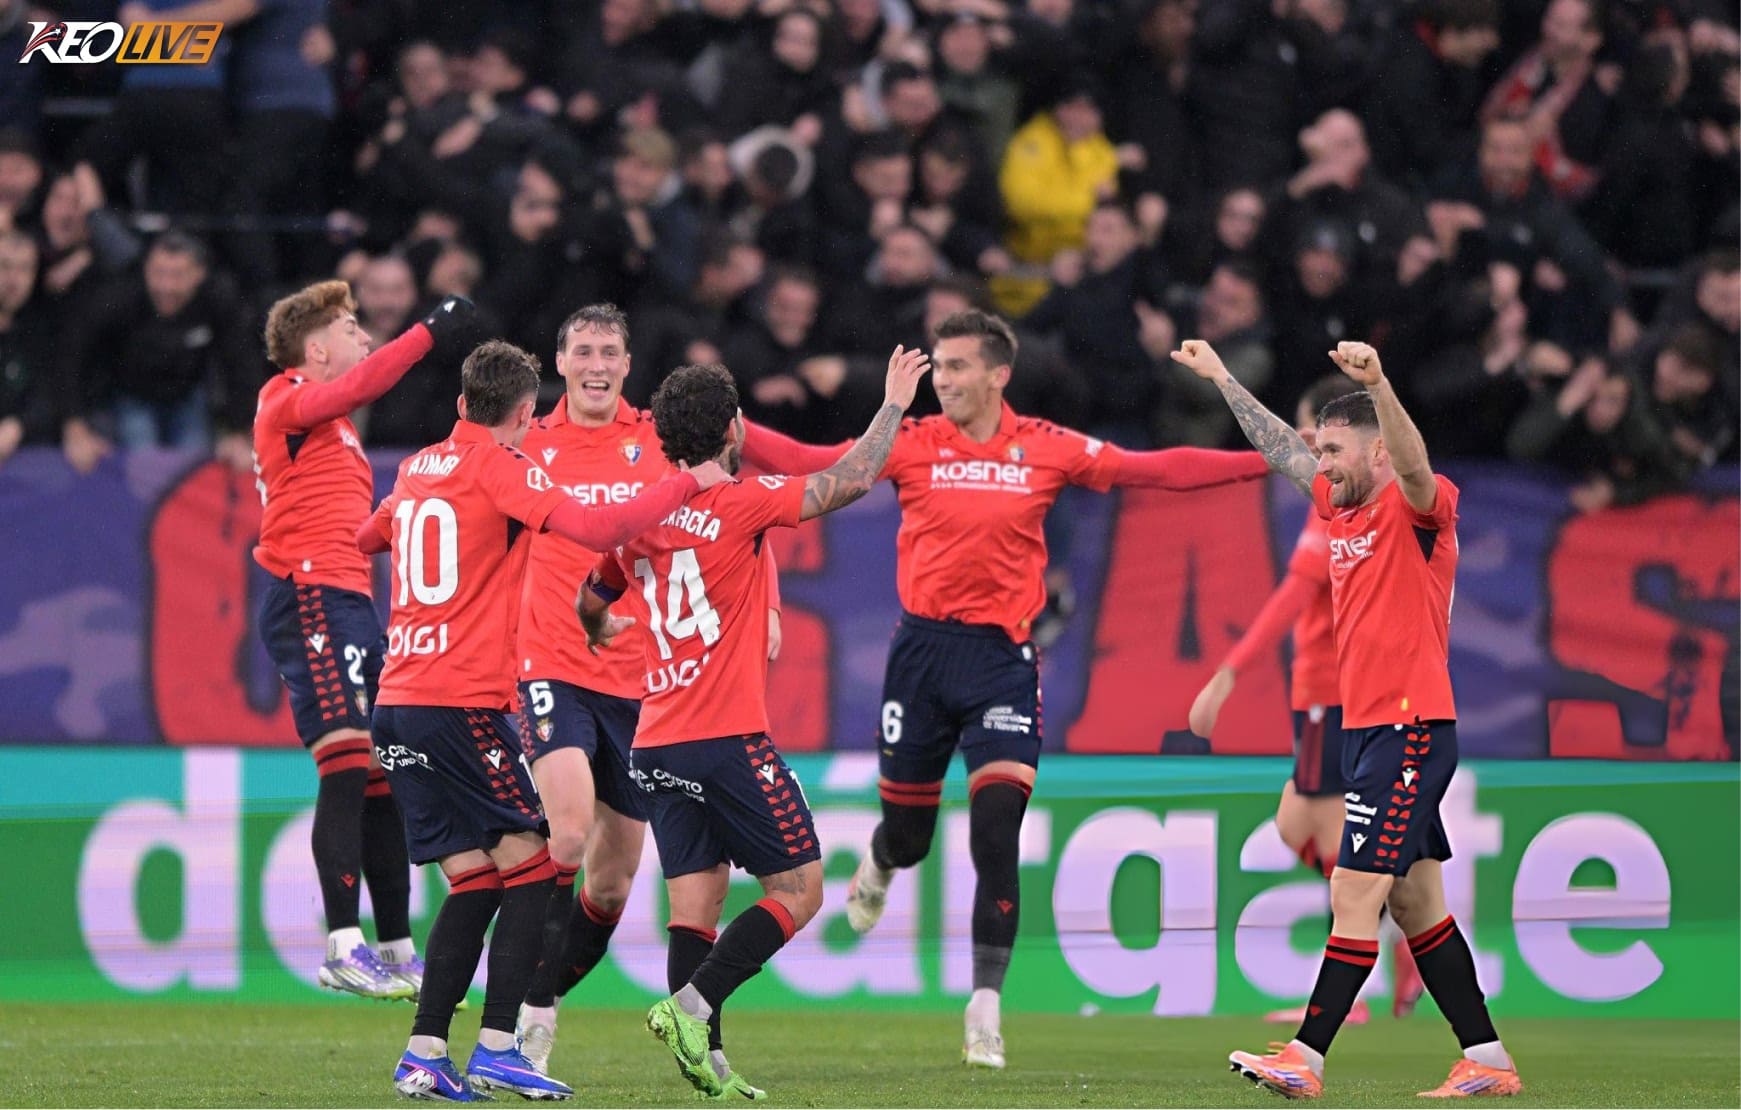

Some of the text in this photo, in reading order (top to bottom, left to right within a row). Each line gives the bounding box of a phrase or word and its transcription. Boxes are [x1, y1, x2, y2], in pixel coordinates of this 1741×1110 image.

[395, 497, 459, 606] 10
[634, 547, 721, 660] 14
[529, 681, 555, 716] 5
[882, 701, 904, 744] 6
